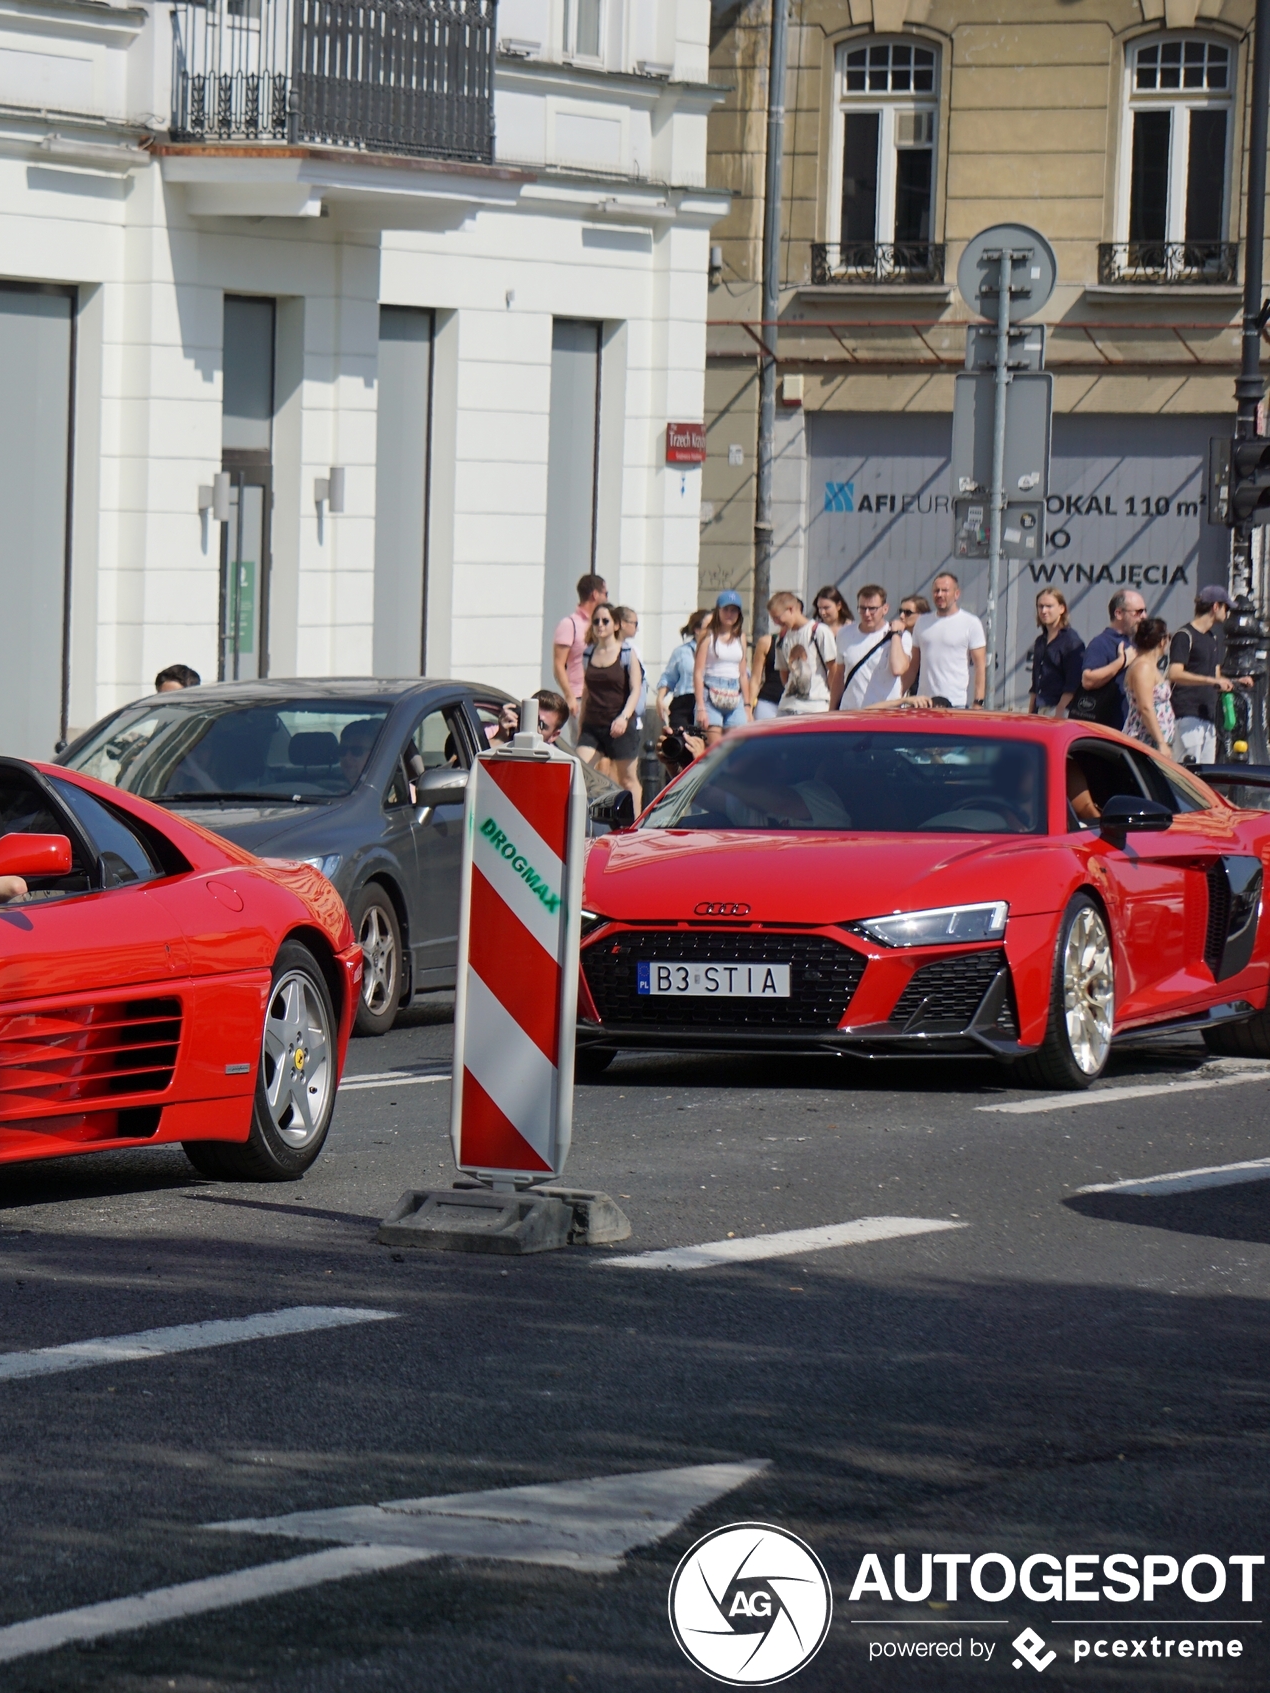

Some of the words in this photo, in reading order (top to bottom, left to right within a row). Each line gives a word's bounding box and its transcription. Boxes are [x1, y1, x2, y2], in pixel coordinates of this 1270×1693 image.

[857, 493, 896, 514] AFI
[901, 493, 956, 515] EUR
[1046, 494, 1118, 516] OKAL
[1124, 495, 1170, 517] 110
[1045, 529, 1071, 549] O
[1029, 563, 1189, 589] WYNAJĘCIA
[479, 817, 562, 915] DROGMAX
[639, 981, 650, 989] PL
[657, 965, 690, 992] B3
[704, 966, 777, 994] STIA
